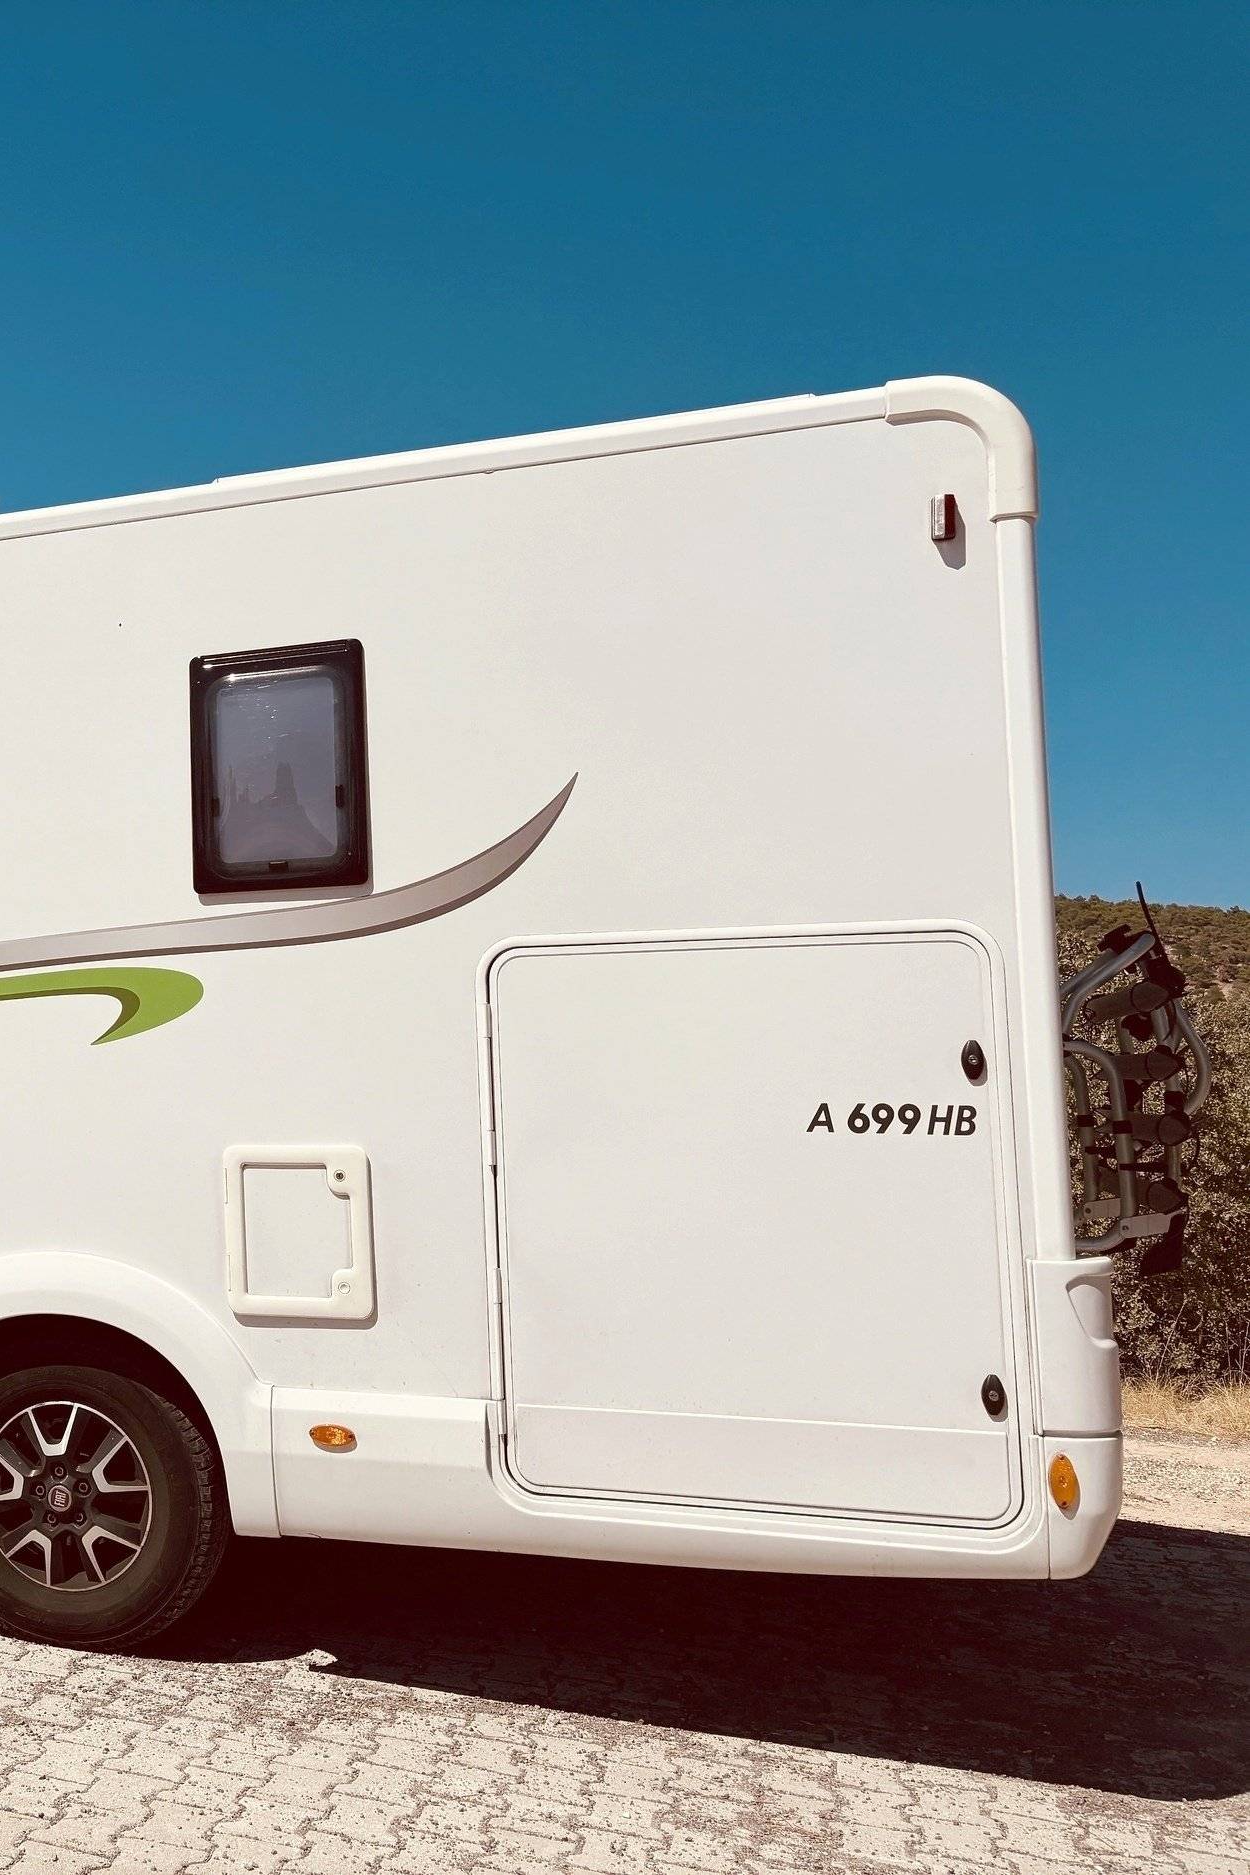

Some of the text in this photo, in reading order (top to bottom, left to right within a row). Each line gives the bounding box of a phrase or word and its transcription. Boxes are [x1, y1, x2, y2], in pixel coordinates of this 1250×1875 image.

[806, 1102, 977, 1136] A 699 HB
[54, 1490, 66, 1506] FIAT
